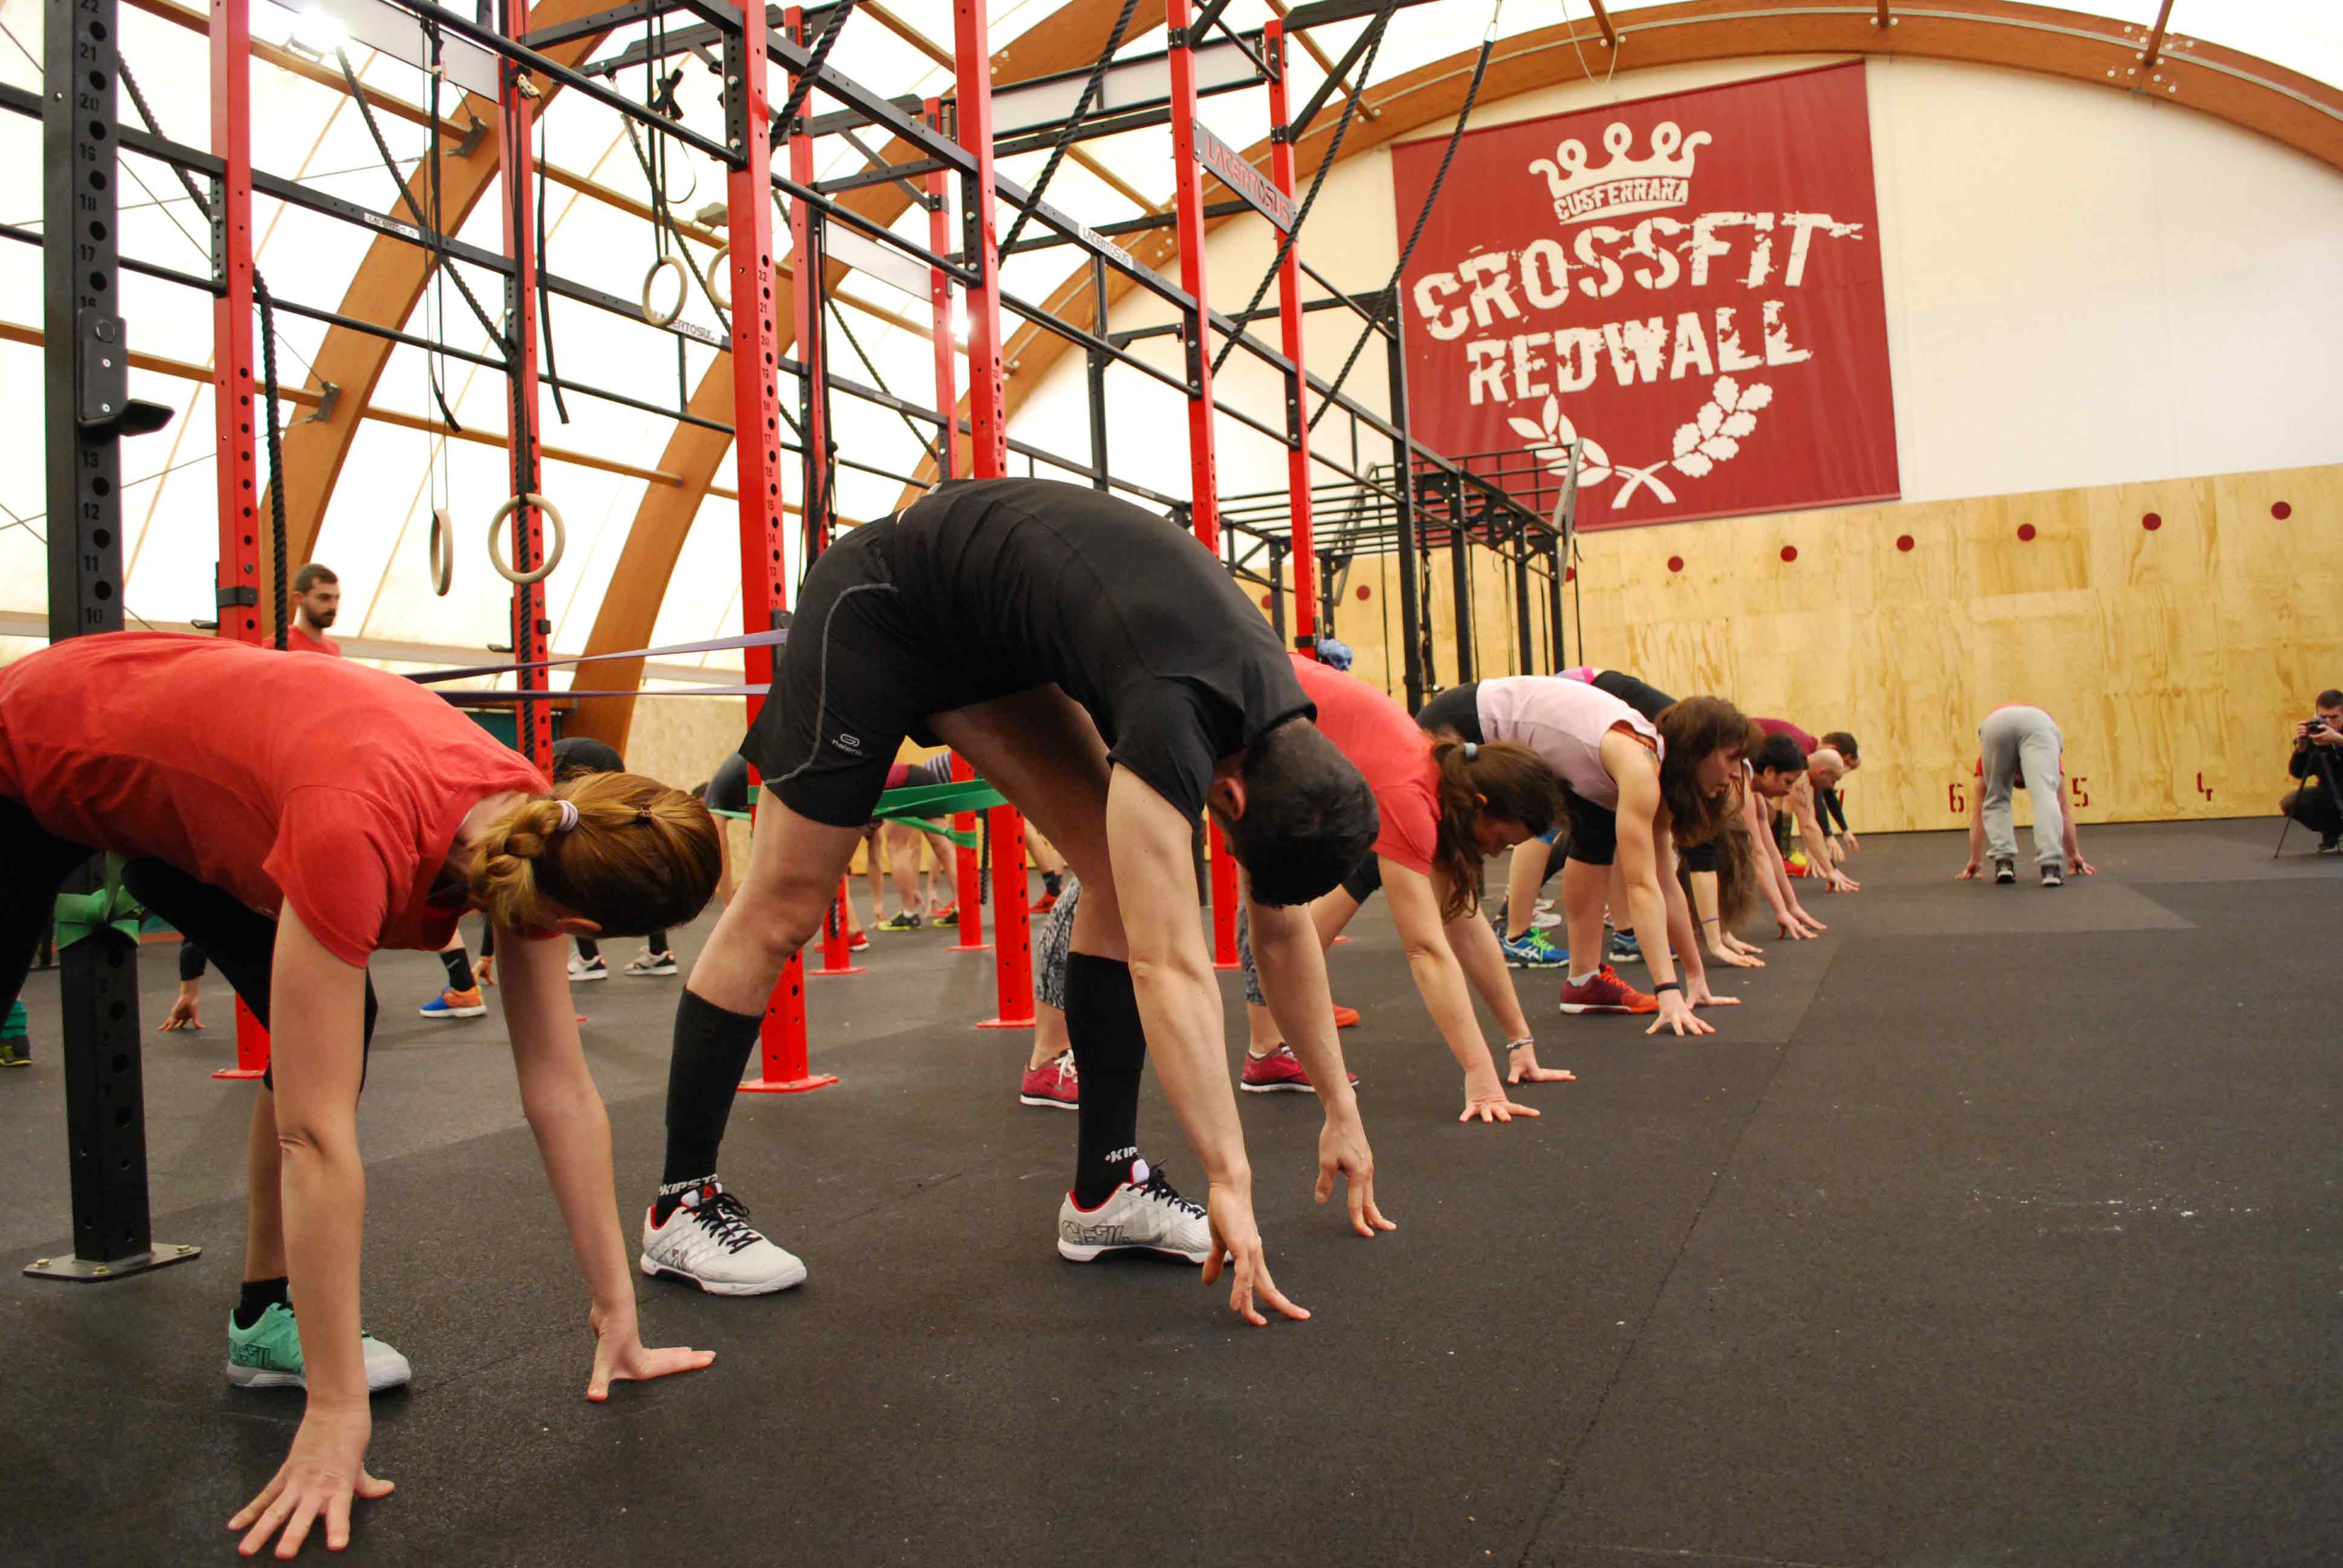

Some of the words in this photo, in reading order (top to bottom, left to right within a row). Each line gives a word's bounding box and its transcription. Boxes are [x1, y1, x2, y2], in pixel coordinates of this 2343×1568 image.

[80, 43, 97, 62] 21
[80, 93, 99, 111] 20
[1207, 135, 1290, 226] LACERTOSUS
[1553, 178, 1689, 221] CUSFERRARA
[80, 244, 96, 262] 17
[758, 269, 767, 283] 22
[1413, 211, 1863, 341] CROSSFIT
[759, 302, 768, 315] 21
[1466, 300, 1814, 407] REDWALL
[82, 451, 99, 468] 13
[84, 503, 100, 520] 12
[84, 555, 99, 572] 11
[85, 607, 103, 624] 10
[2072, 777, 2088, 807] 5
[2197, 772, 2213, 802] 4
[1949, 783, 1964, 812] 6
[1111, 1146, 1138, 1163] KIP
